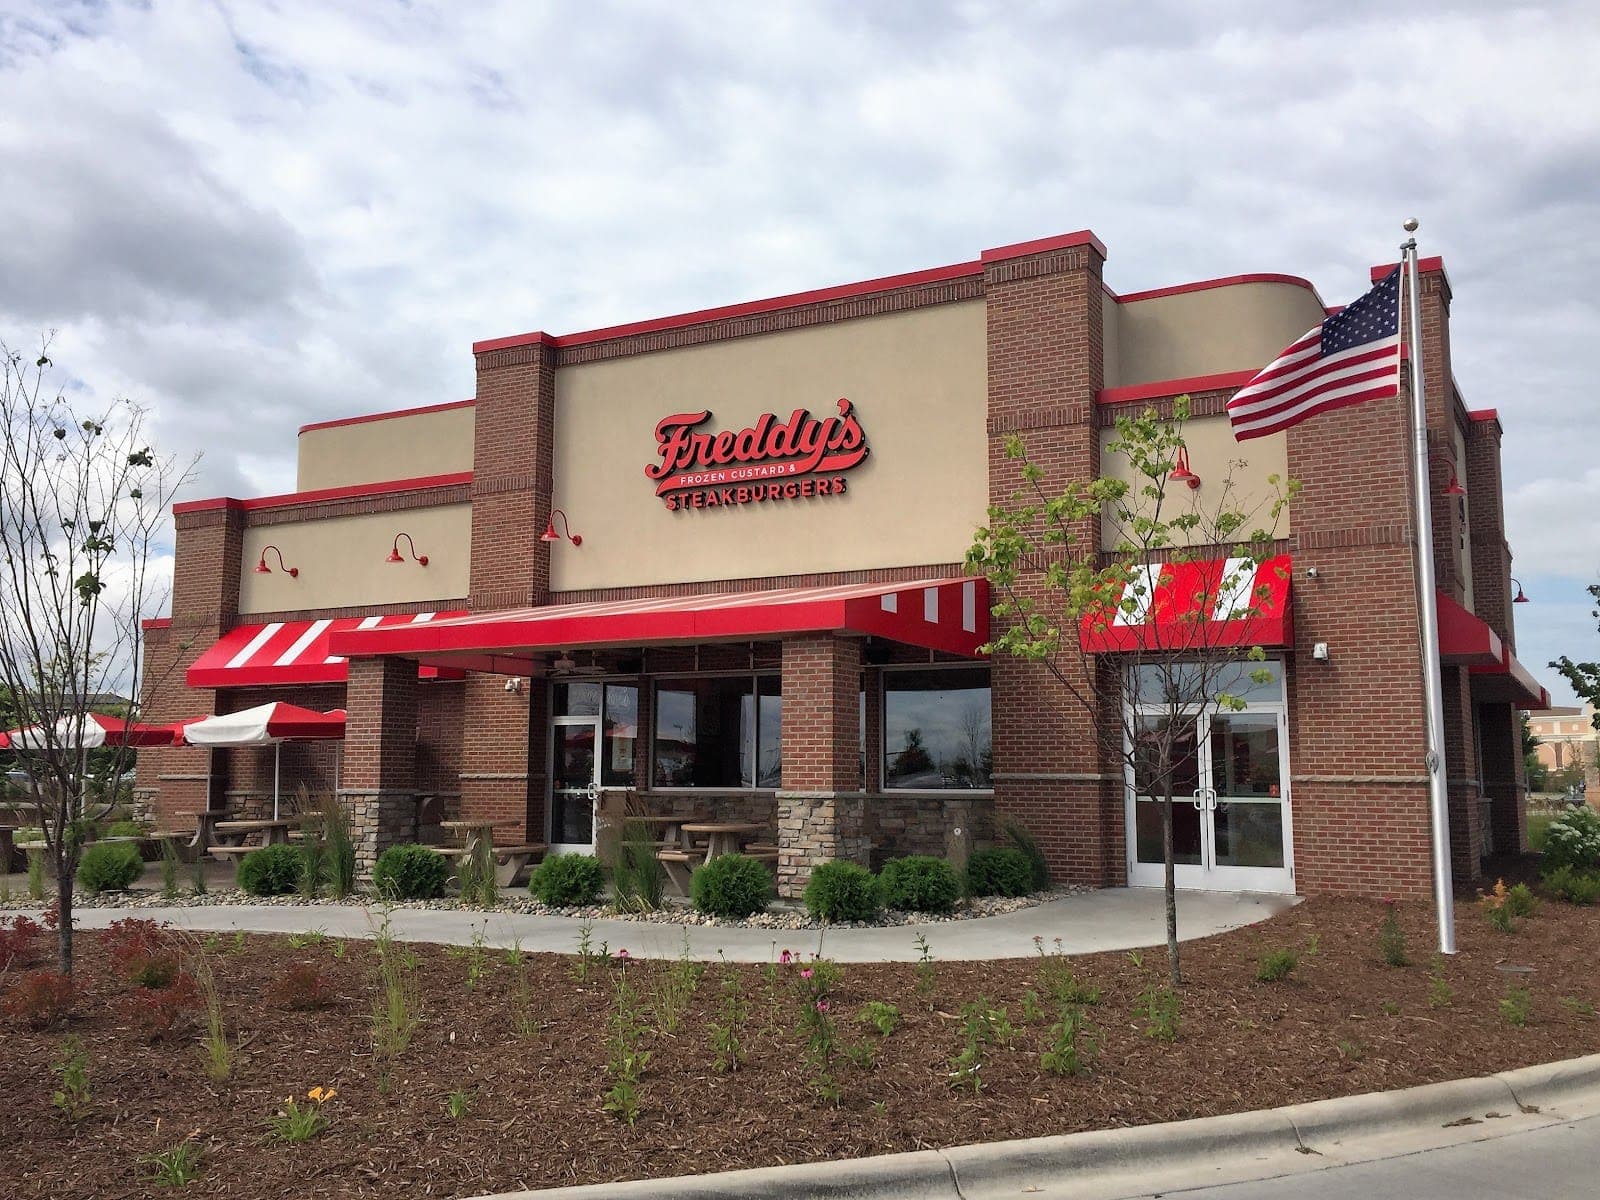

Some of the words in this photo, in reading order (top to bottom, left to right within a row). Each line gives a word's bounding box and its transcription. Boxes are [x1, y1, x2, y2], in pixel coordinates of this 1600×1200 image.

[645, 398, 869, 483] Freddy's
[680, 472, 726, 485] FROZEN
[731, 465, 785, 479] CUSTARD
[789, 464, 796, 473] &
[666, 476, 846, 511] STEAKBURGERS
